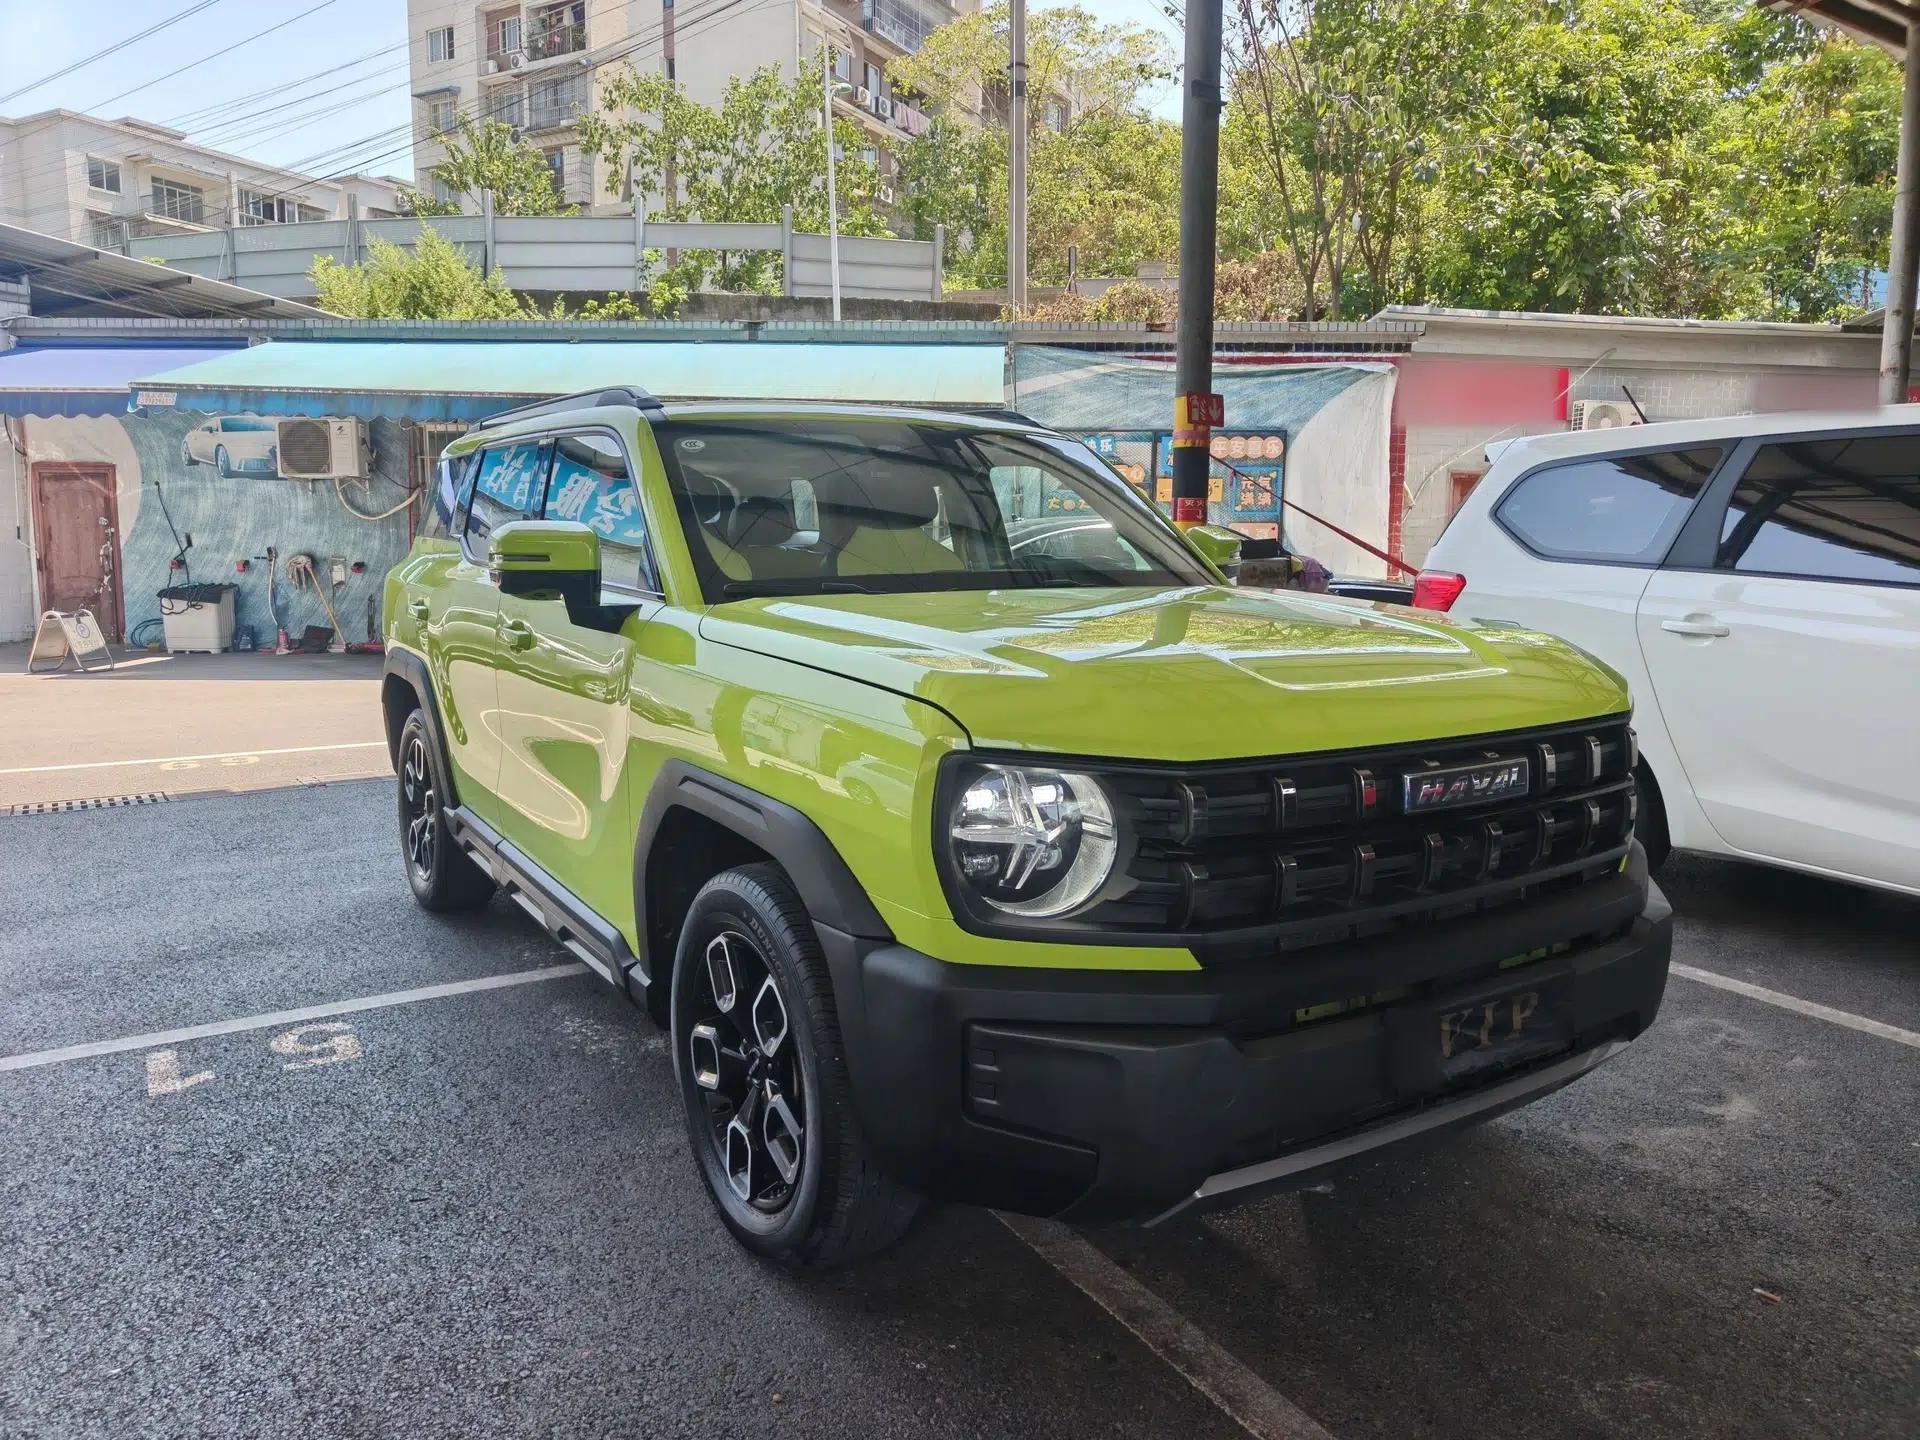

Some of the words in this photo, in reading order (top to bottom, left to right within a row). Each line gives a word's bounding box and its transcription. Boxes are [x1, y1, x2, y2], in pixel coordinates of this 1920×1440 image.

[1213, 441, 1281, 456] 平安喜乐
[1416, 766, 1526, 806] HAVAL
